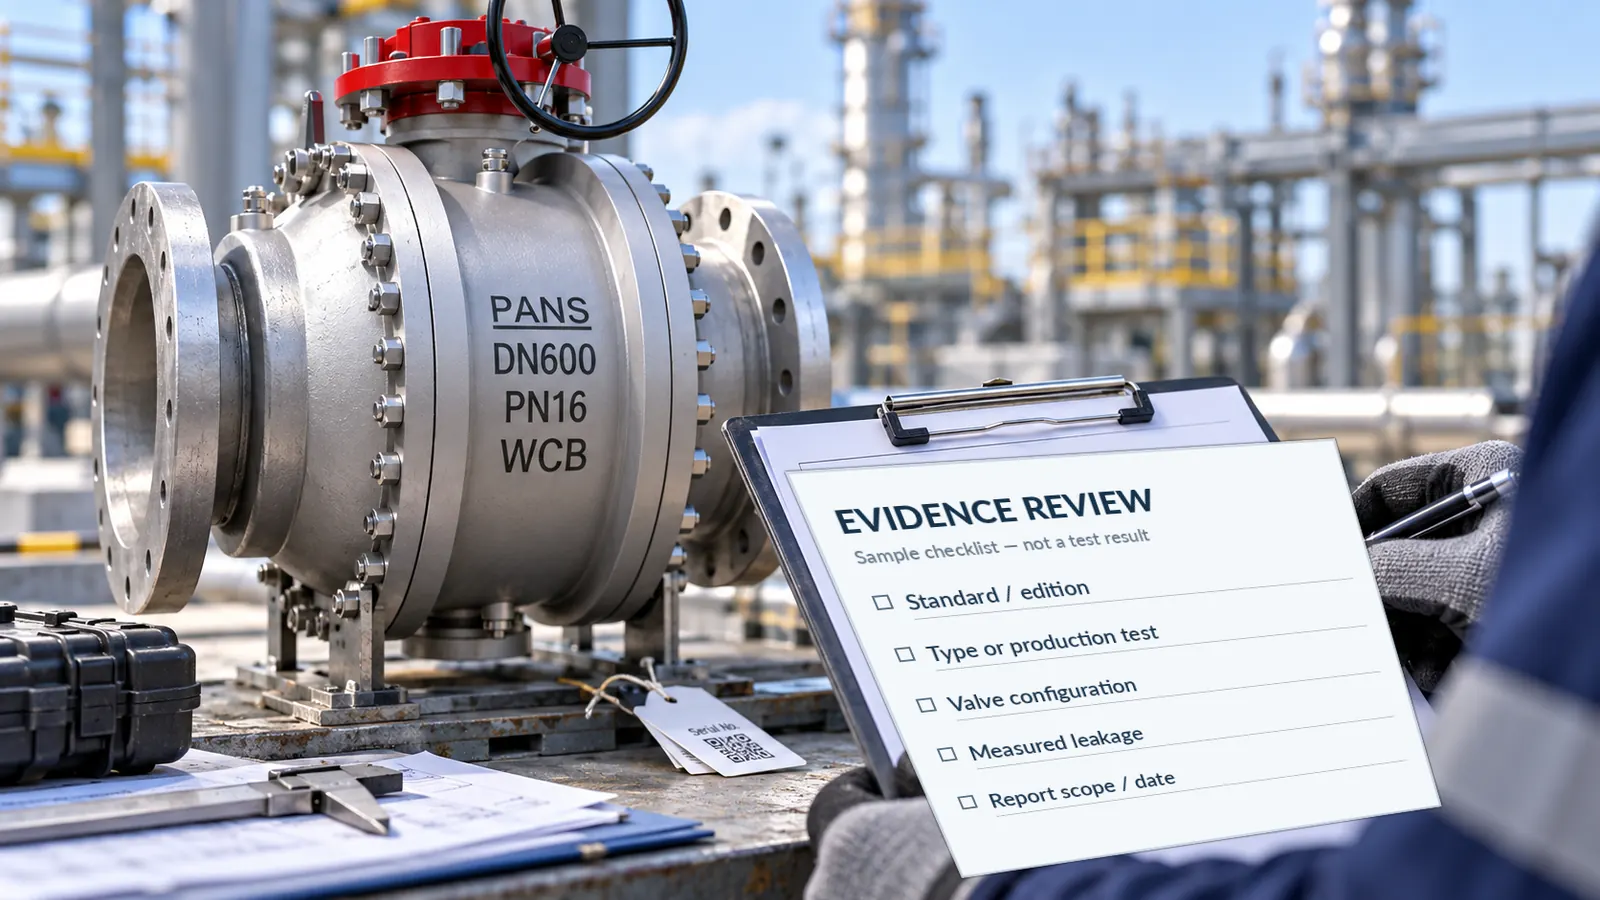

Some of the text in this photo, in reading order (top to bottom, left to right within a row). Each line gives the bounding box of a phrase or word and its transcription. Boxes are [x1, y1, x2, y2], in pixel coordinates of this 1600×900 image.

[490, 295, 589, 324] PANS
[493, 342, 596, 375] DN600
[505, 390, 587, 423] PN16
[500, 437, 587, 473] WCB
[835, 489, 1151, 535] EVIDENCE REVIEW
[854, 547, 920, 566] Sample
[925, 541, 999, 559] checklist
[1023, 537, 1053, 551] not
[1056, 539, 1065, 549] a
[1069, 534, 1102, 548] test
[1105, 529, 1151, 545] result
[906, 587, 1000, 611] Standard
[1020, 581, 1090, 601] edition
[925, 626, 1160, 665] Type or production test
[946, 680, 1138, 712] Valve configuration
[969, 730, 1144, 762] Measured leakage
[989, 787, 1057, 809] Report
[1061, 782, 1117, 799] scope
[1135, 773, 1176, 789] date
